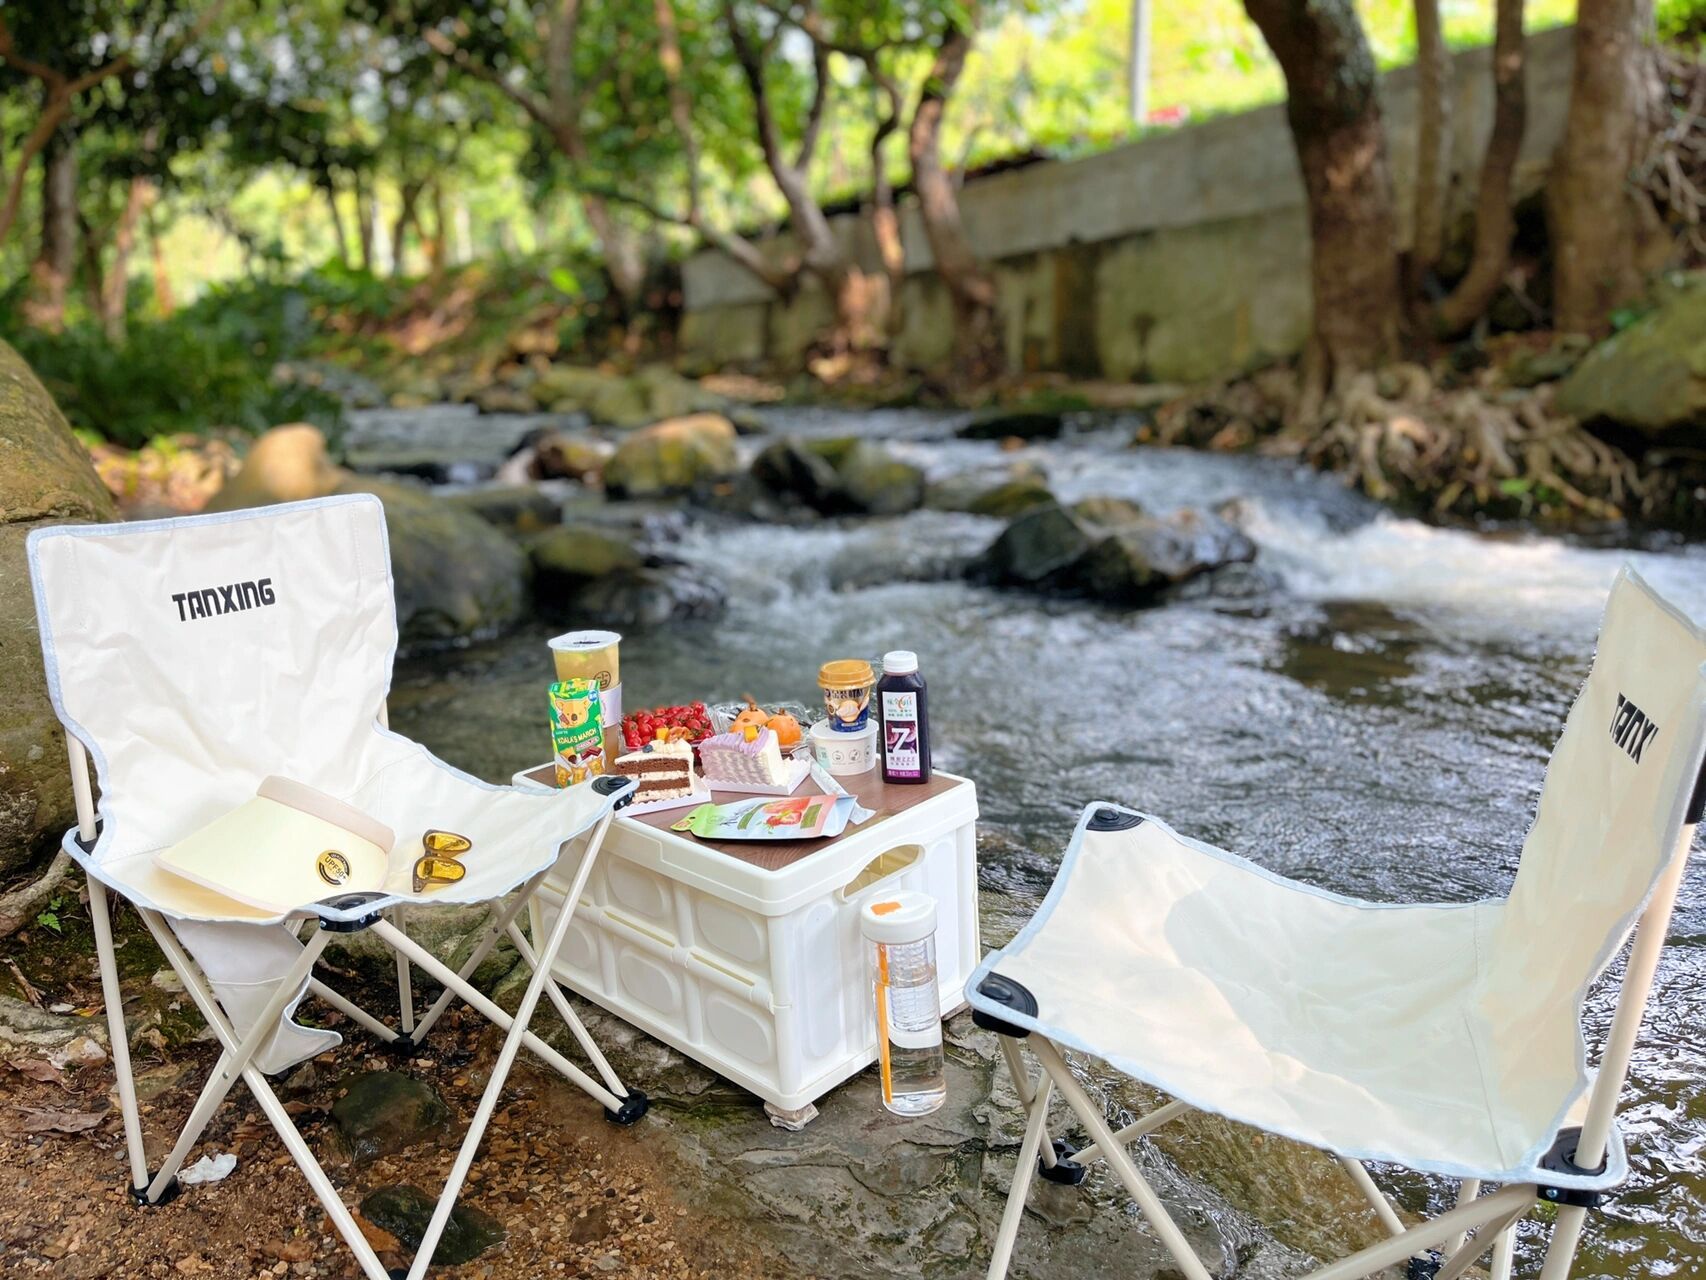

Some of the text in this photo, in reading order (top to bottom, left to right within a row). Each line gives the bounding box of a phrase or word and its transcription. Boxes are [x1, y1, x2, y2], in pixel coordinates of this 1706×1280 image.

[172, 578, 275, 621] TANXING
[557, 735, 577, 744] KOALA'S
[578, 728, 596, 740] MARCH
[891, 727, 911, 753] Z
[1609, 692, 1659, 765] TANX
[324, 856, 346, 879] UPF50+
